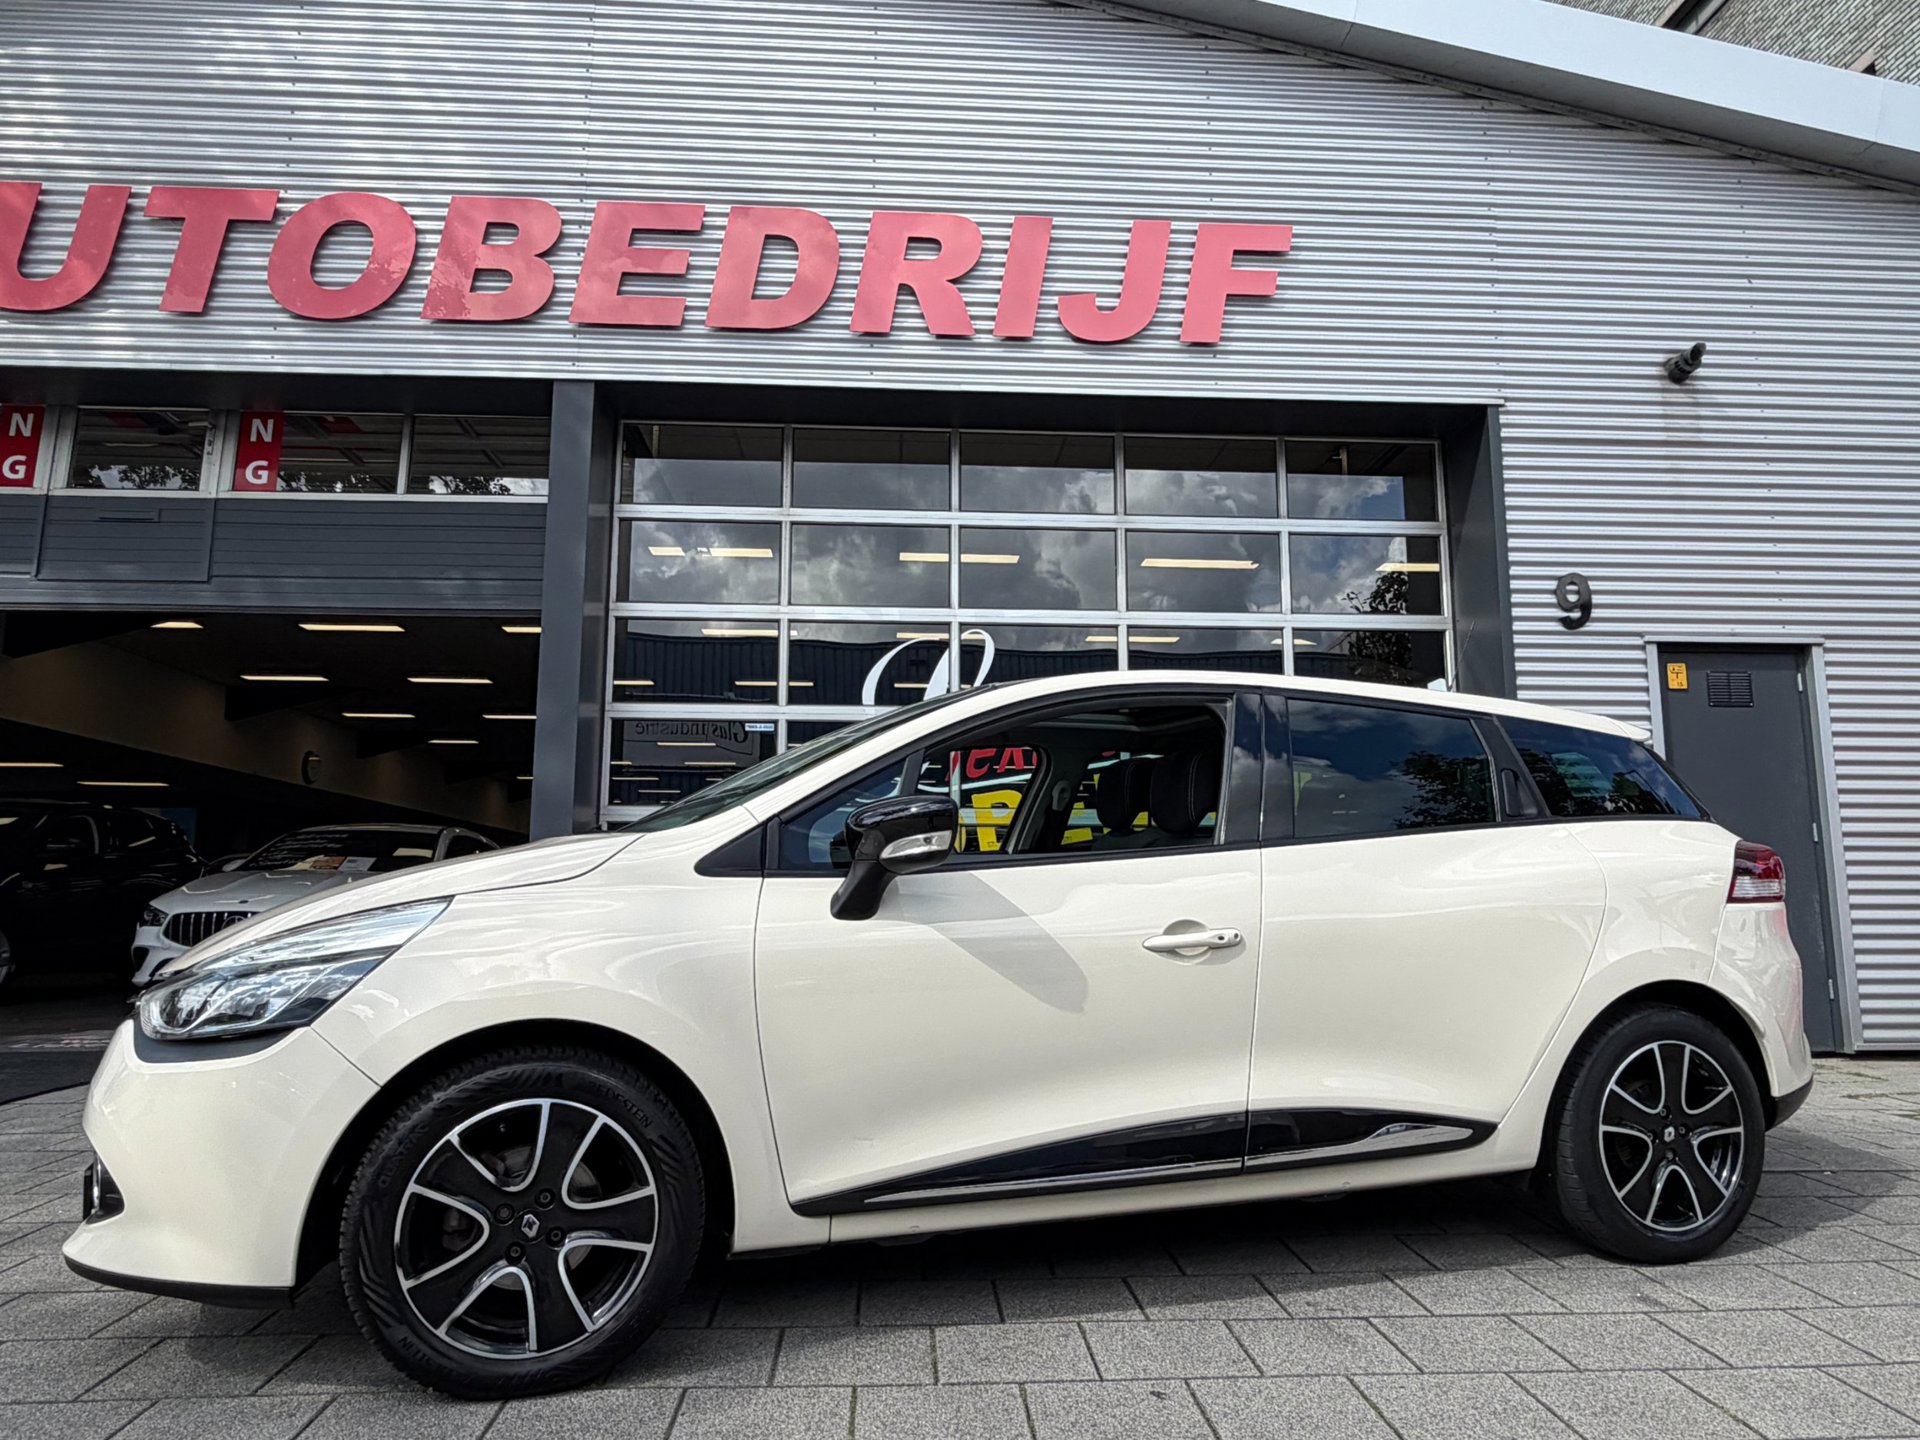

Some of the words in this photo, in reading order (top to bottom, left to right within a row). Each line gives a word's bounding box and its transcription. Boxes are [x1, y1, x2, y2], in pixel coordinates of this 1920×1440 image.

[8, 412, 35, 437] N
[249, 418, 275, 443] N
[1, 454, 27, 480] G
[244, 459, 270, 485] G
[1554, 572, 1593, 630] 9
